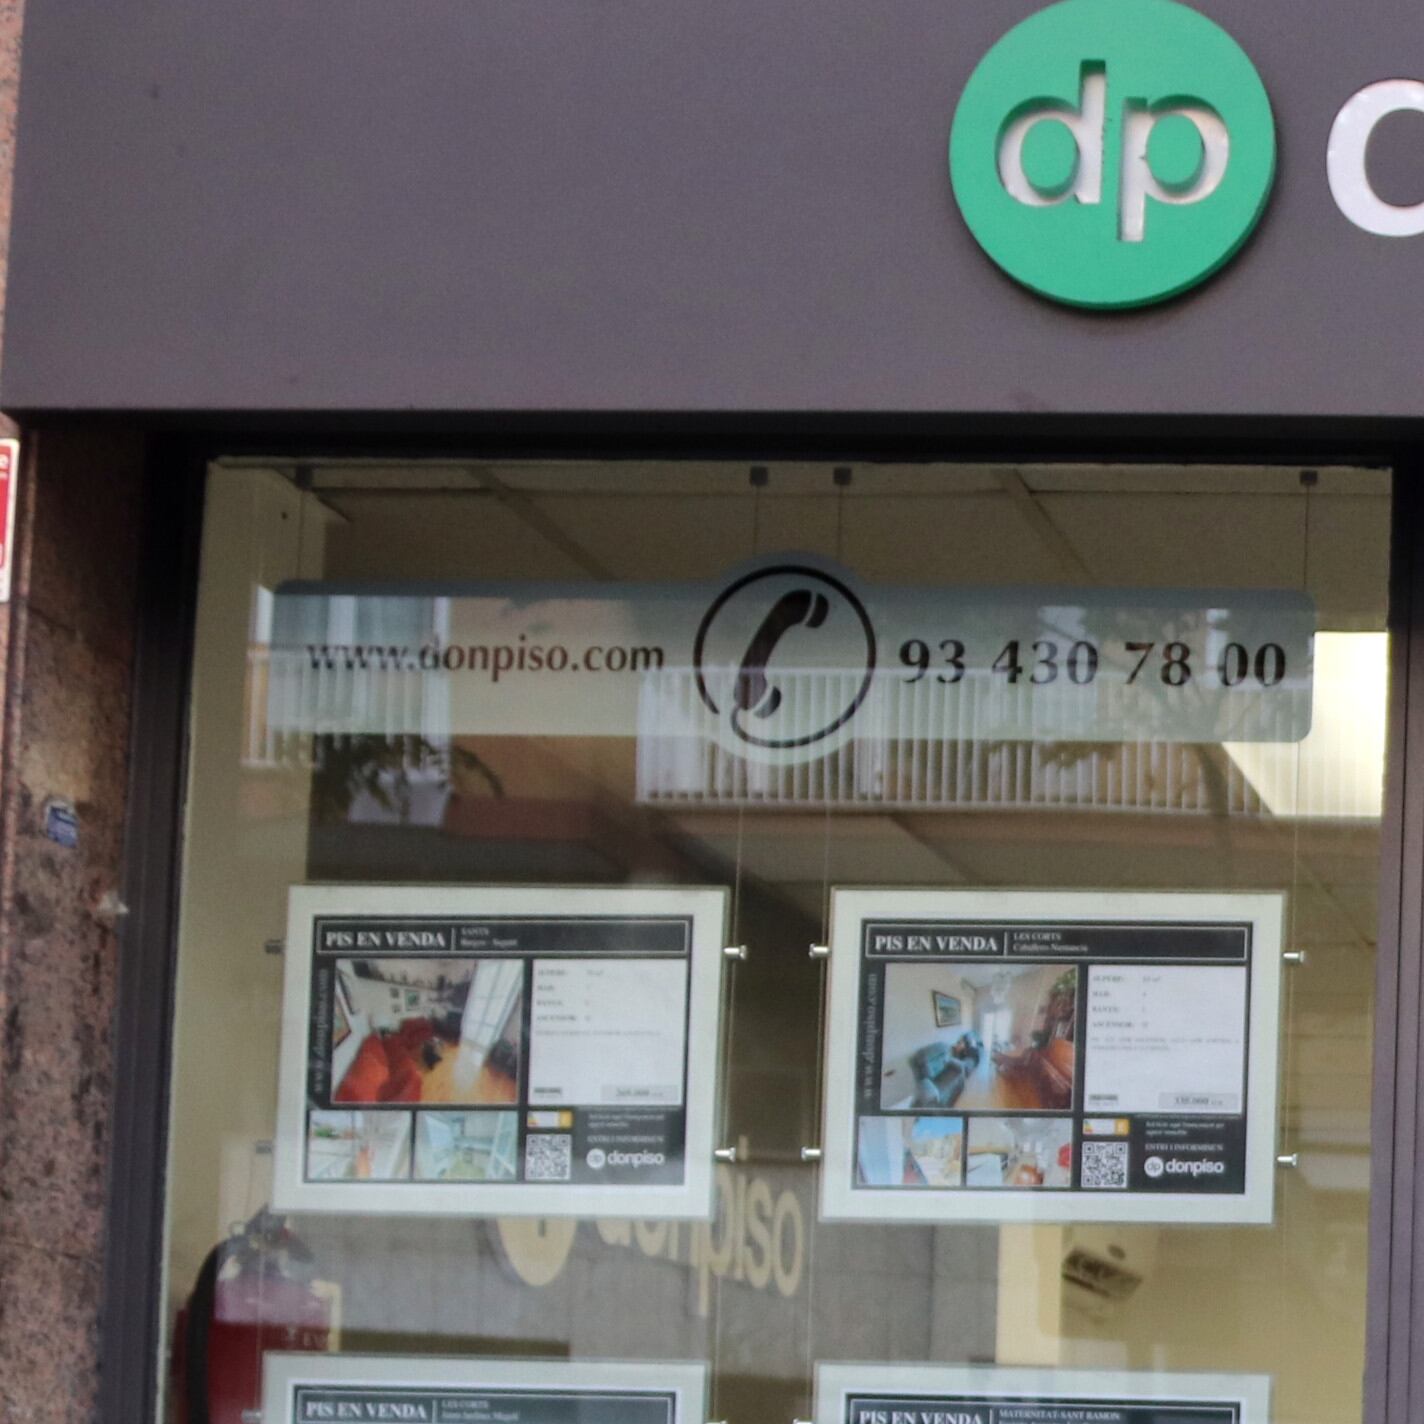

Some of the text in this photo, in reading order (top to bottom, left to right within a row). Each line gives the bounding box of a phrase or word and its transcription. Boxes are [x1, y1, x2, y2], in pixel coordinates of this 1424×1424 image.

[995, 60, 1230, 242] dp
[306, 635, 665, 684] www.donpiso.com
[899, 640, 1288, 687] 93 430 78 00
[326, 932, 353, 947] PIS
[357, 932, 380, 947] EN
[385, 932, 446, 947] VENDA
[875, 936, 998, 952] PIS EN VENDA
[607, 1148, 665, 1169] donpiso
[1165, 1157, 1224, 1177] donpiso
[306, 1401, 335, 1418] PIS
[338, 1402, 362, 1419] EN
[366, 1402, 427, 1420] VENDA
[860, 1410, 887, 1424] PIS
